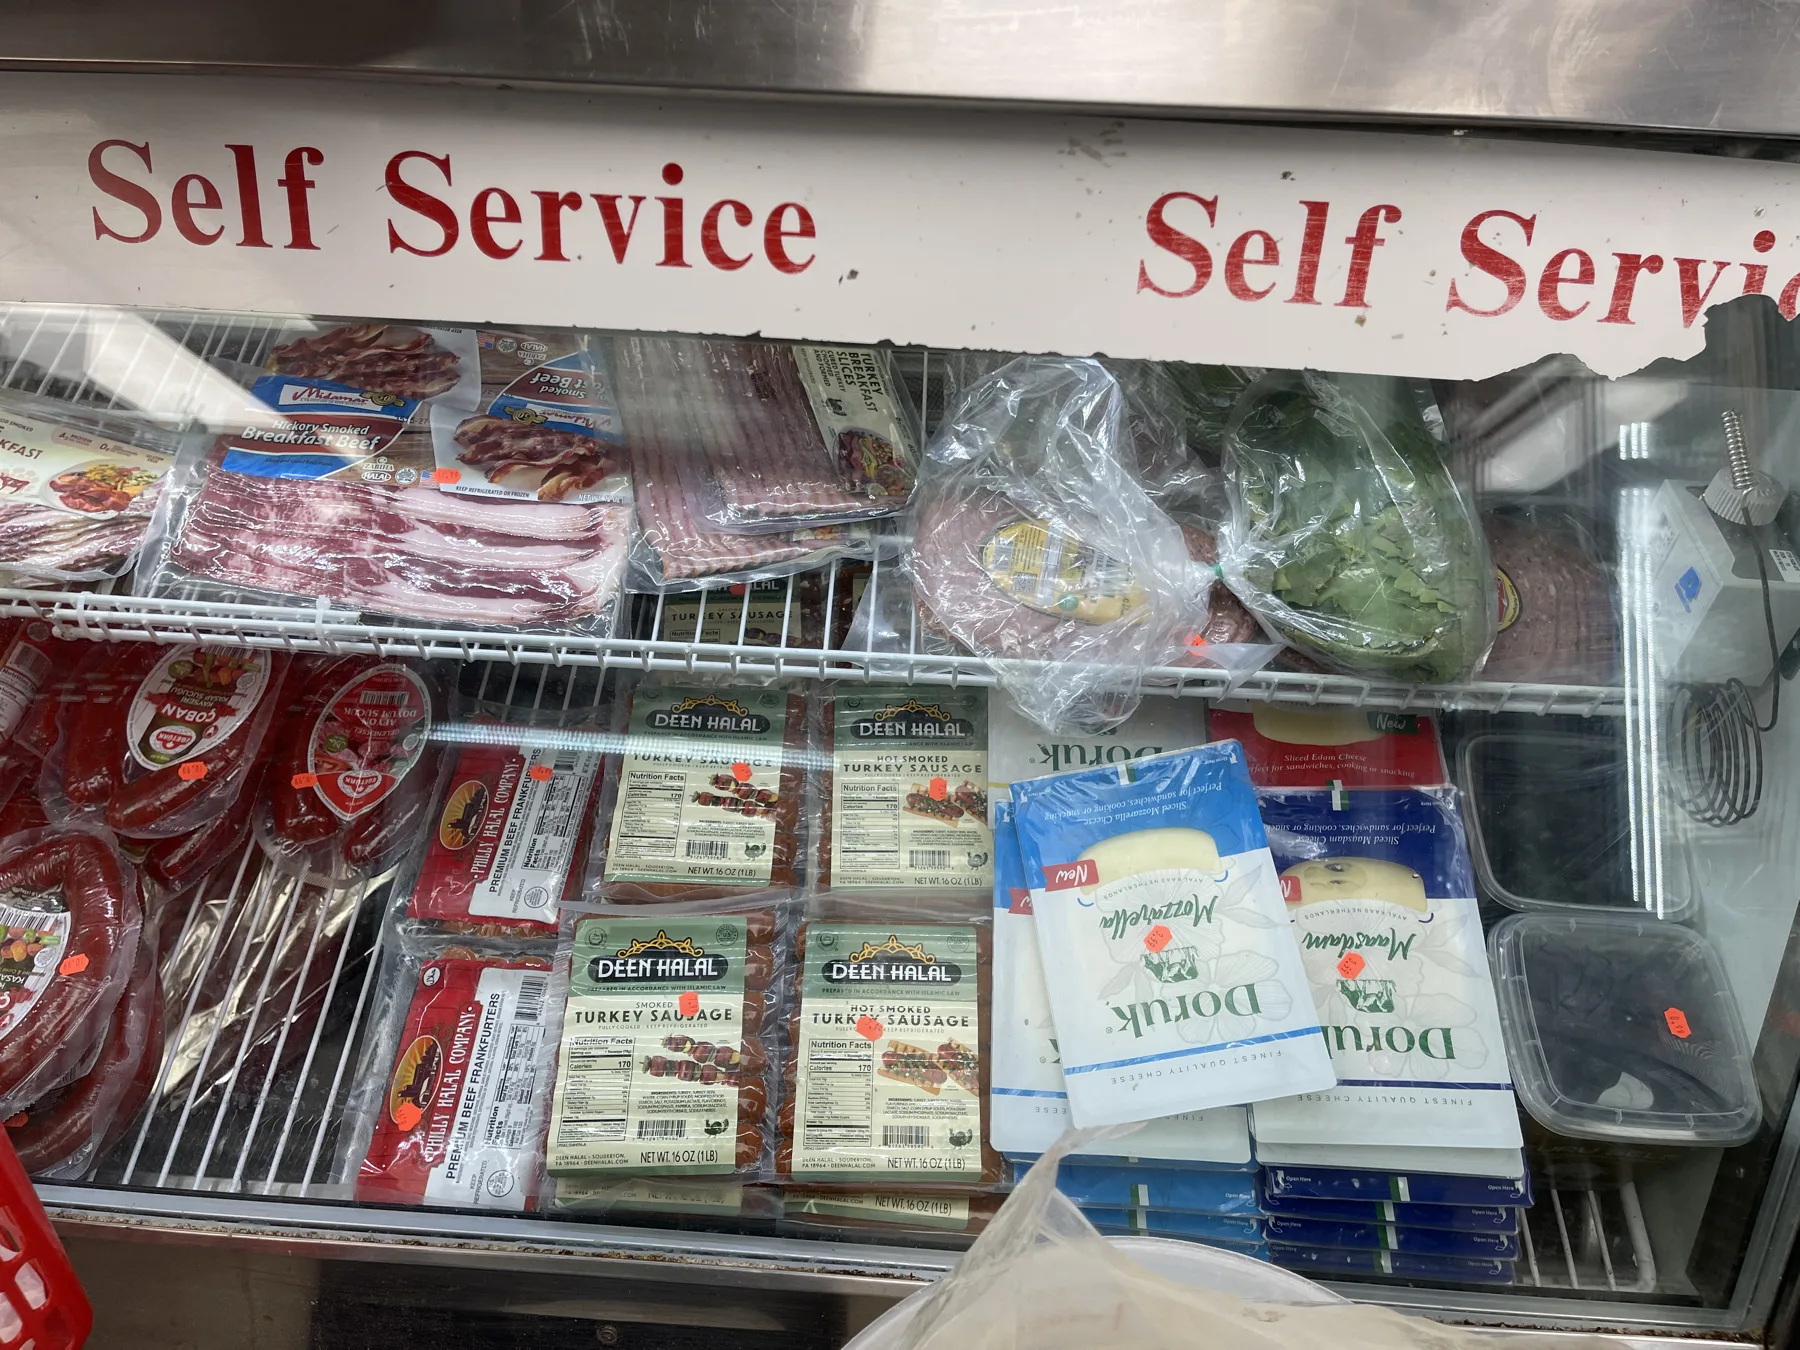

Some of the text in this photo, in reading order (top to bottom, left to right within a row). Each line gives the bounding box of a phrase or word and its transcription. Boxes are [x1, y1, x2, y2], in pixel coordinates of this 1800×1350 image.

[87, 138, 817, 276] Self Service
[1136, 191, 1402, 308] Self
[813, 349, 831, 387] AND FORMED
[820, 350, 834, 377] CHOPPED
[827, 350, 846, 393] CURED TURKEY
[836, 351, 857, 386] SLICES
[530, 372, 573, 389] Beef
[849, 352, 878, 412] BREAKFAST
[861, 353, 883, 396] TURKEY
[292, 386, 369, 404] Midamar
[539, 385, 587, 399] Smoked
[272, 419, 371, 435] Hickory Smoked
[241, 426, 381, 451] Breakfast Beef
[0, 439, 43, 460] KFAST
[362, 472, 390, 482] HALAL
[161, 702, 218, 724] ÇOBAN
[381, 708, 417, 718] DOYUM
[363, 718, 397, 726] AFYON
[654, 713, 762, 732] DEEN HALAL
[859, 722, 966, 737] DEEN HALAL
[1375, 714, 1407, 730] New
[877, 755, 948, 763] HOT SMOKED
[1283, 753, 1368, 762] Sliced Edam Cheese
[630, 772, 685, 781] Nutrition Facts
[843, 764, 982, 773] TURKEY SAUSAGE
[1250, 761, 1416, 779] rfect for sandwiches, cooking or snacking
[843, 784, 897, 792] Nutrition Facts
[1044, 782, 1222, 822] Perfect for sandwiches, cooking or snacking
[470, 762, 520, 874] PHILLY HALAL COMPANY
[1083, 800, 1188, 826] Sliced Mozzarella Cheese
[1264, 824, 1291, 833] snack
[1302, 823, 1338, 834] cooking
[1338, 823, 1390, 833] sandwiches,
[1391, 823, 1407, 835] for
[1407, 823, 1436, 834] Perfect
[1295, 834, 1400, 845] Sliced Maasdam Cheese
[523, 838, 538, 868] Nutrition
[687, 866, 757, 878] NET WT. 16 OZ (1 LB)
[1055, 864, 1089, 886] New
[1099, 893, 1219, 940] Mozzarella
[1147, 929, 1165, 949] 3.99
[1301, 927, 1417, 961] Maasdam
[598, 957, 718, 978] DEEN HALAL
[832, 964, 952, 982] DEEN HALAL
[1339, 956, 1358, 976] 3.99
[0, 973, 26, 984] KASA
[635, 1001, 674, 1009] SMOKED
[850, 1004, 931, 1014] HOT SMOKED
[1110, 983, 1263, 1039] Doruk
[575, 1009, 644, 1024] TURKEY
[812, 1012, 969, 1027] TURKY SAUSAGE
[570, 1037, 633, 1046] Nutrition Facts
[811, 1040, 872, 1049] Nutrition Facts
[461, 1086, 477, 1120] BEEF
[470, 993, 500, 1085] FRANKFURTERS
[617, 1060, 631, 1068] 170
[858, 1064, 872, 1072] 170
[1110, 1051, 1282, 1085] FINEST QUALITY CHEESE
[425, 1012, 476, 1156] PHILLY HALAL COMPANY
[1296, 1094, 1473, 1106] FINEST QUALITY CHEESE
[887, 1157, 966, 1170] NET WT. 16 OZ (1 LB)
[1286, 1175, 1298, 1183] Open
[1487, 1184, 1501, 1192] Open
[875, 1196, 952, 1216] NET WT. 16 OZ (1 LB)
